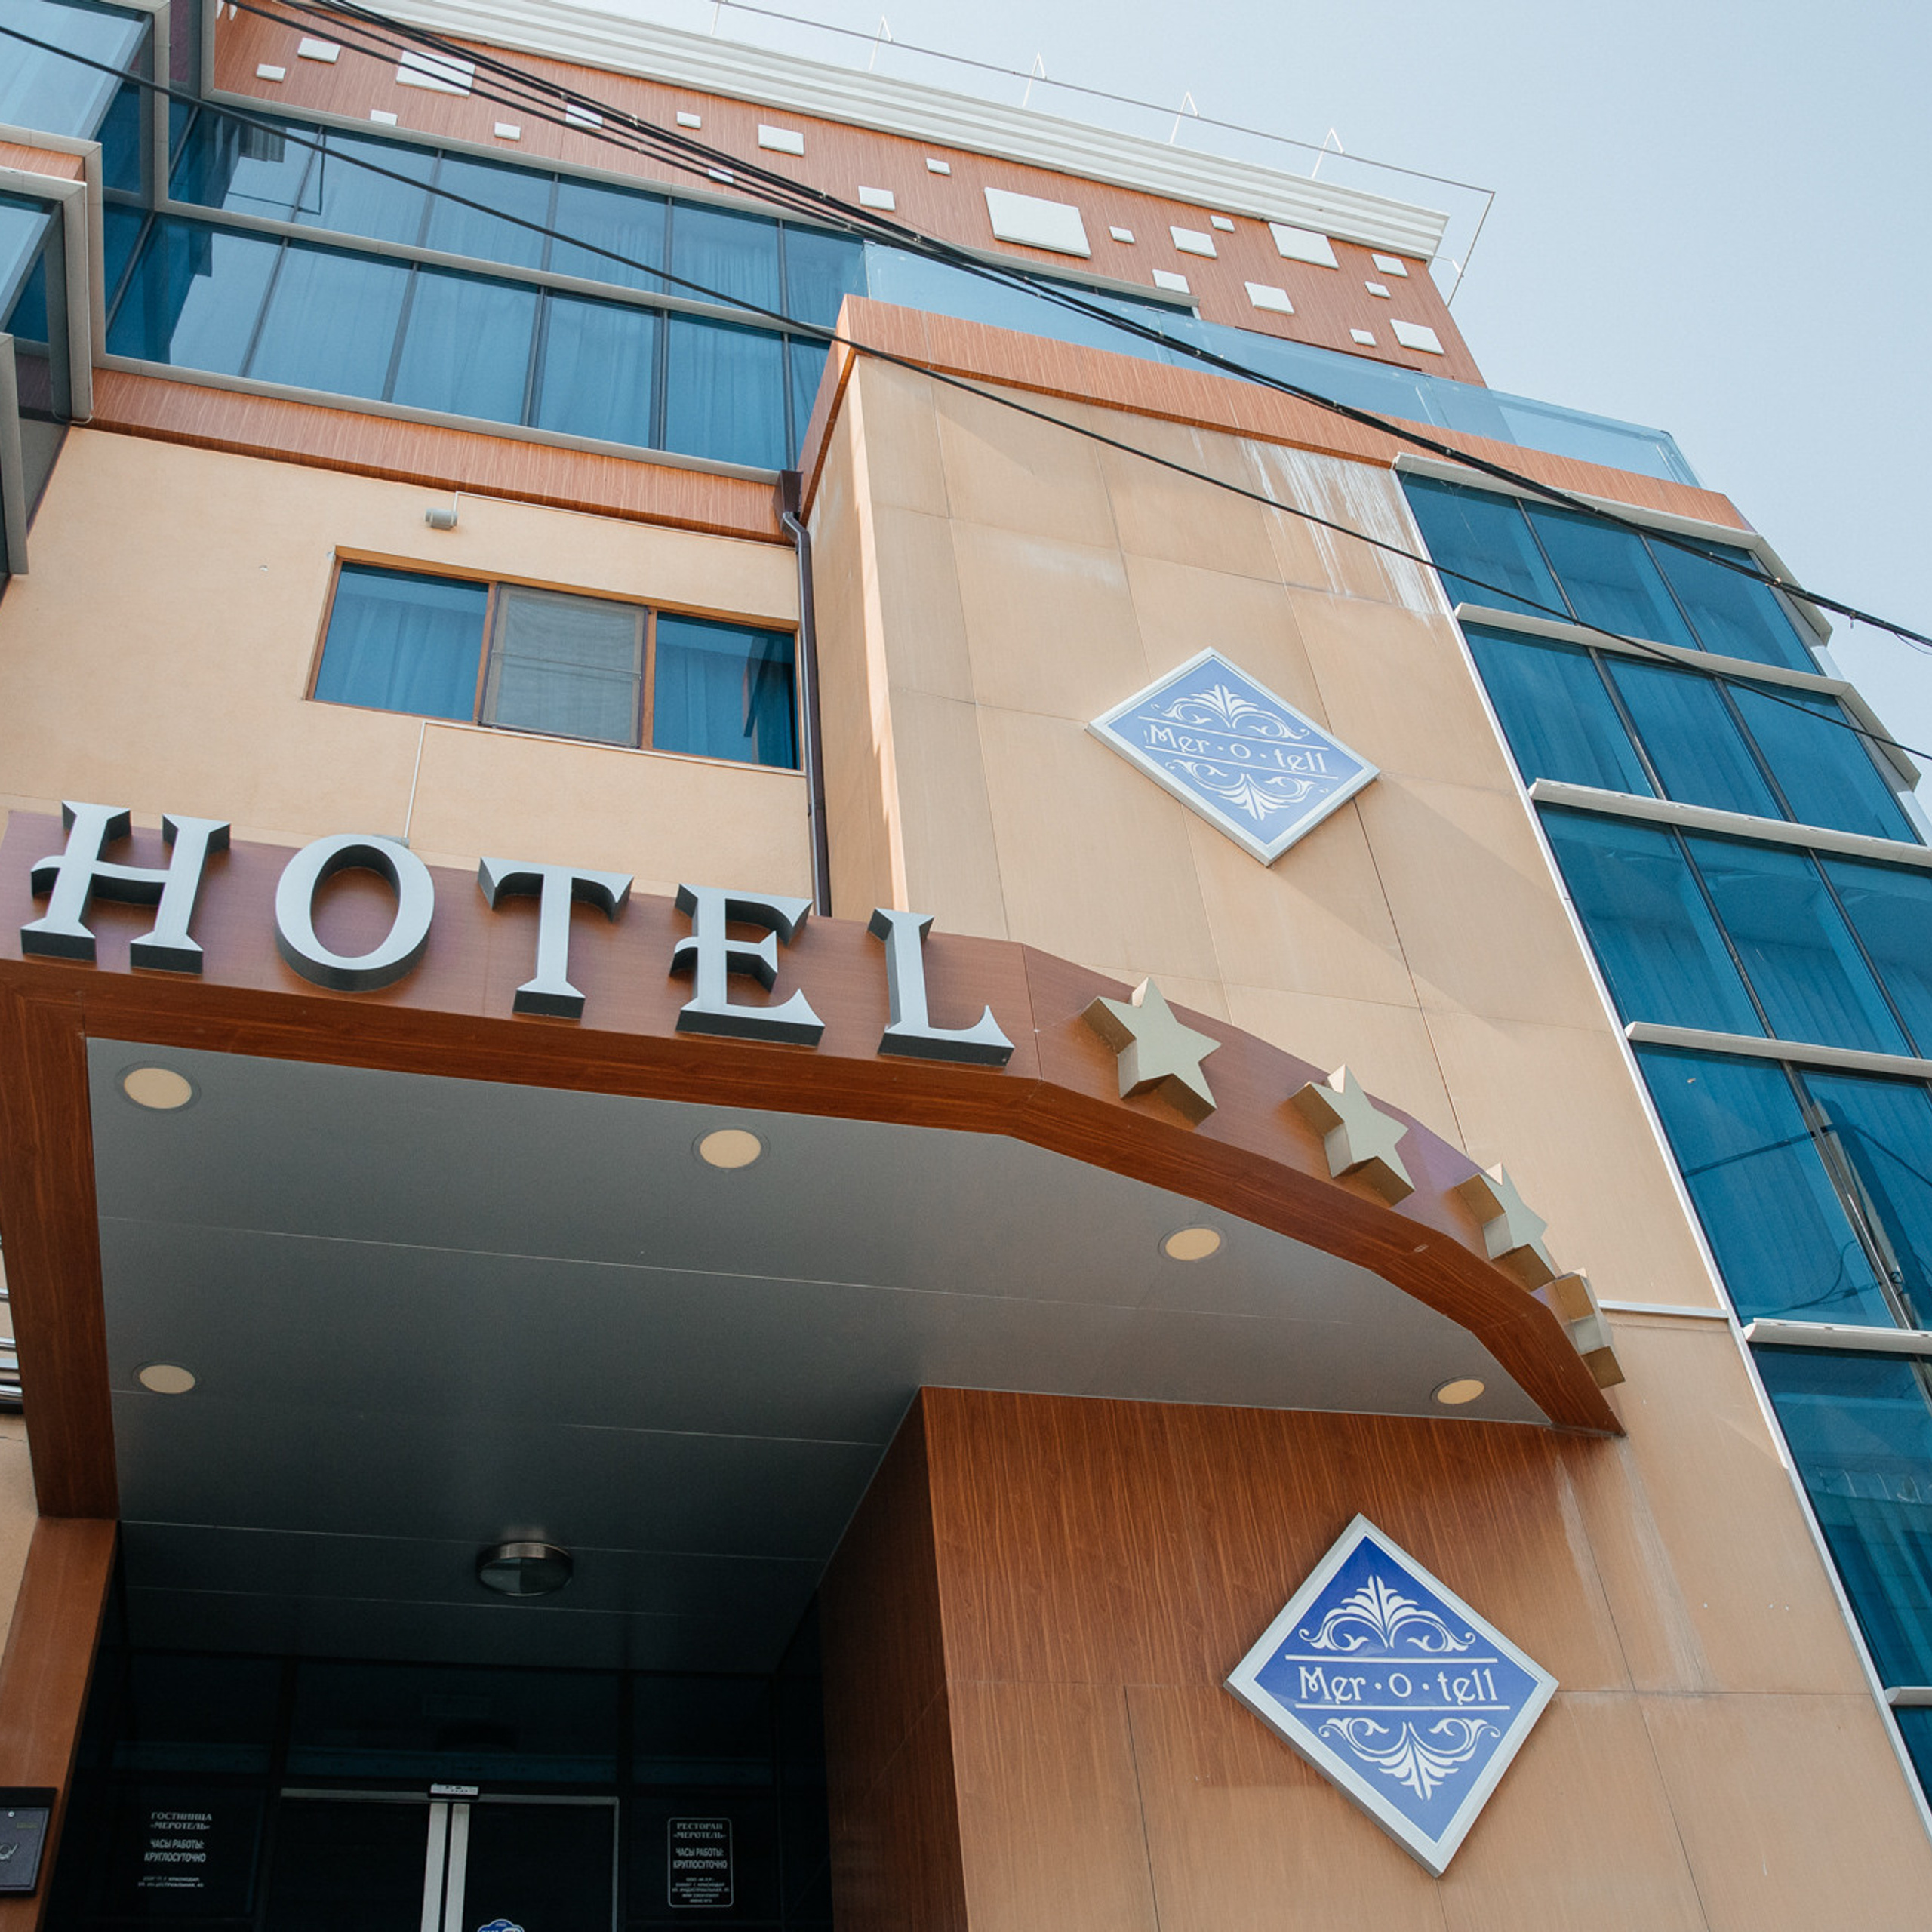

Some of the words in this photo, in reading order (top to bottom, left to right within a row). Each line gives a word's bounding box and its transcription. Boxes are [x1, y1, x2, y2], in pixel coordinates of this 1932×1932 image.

[20, 800, 1014, 1066] HOTEL
[151, 1812, 212, 1821] ГОСТИНИЦА
[150, 1839, 171, 1849] ЧАСЫ
[675, 1847, 695, 1857] ЧАСЫ
[144, 1852, 206, 1863] КРУГЛОСУТОЧНО
[673, 1860, 728, 1869] КРУГЛОСУТОЧНО
